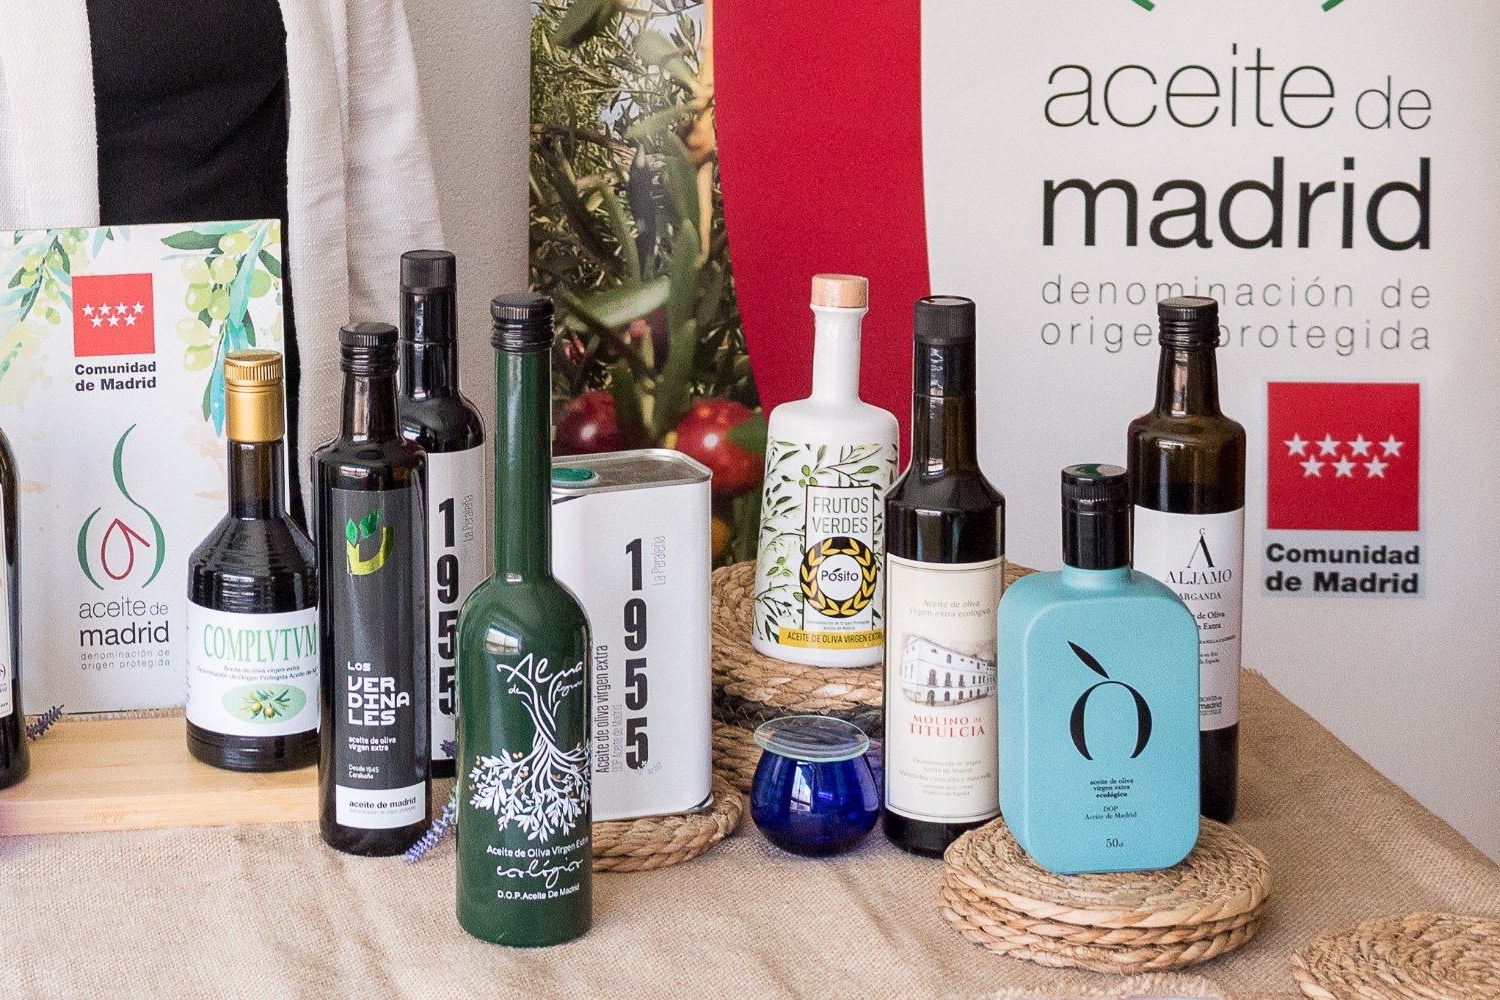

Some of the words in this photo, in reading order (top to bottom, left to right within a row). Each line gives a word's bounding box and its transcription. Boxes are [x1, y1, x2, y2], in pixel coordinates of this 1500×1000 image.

[1044, 43, 1335, 128] aceite
[1355, 75, 1432, 130] de
[1042, 156, 1432, 250] madrid
[1041, 274, 1354, 308] denominación
[1381, 278, 1431, 309] de
[1041, 316, 1153, 353] orige
[75, 361, 156, 375] Comunidad
[75, 380, 95, 391] de
[100, 376, 156, 390] Madrid
[813, 497, 869, 513] FRUTOS
[812, 517, 868, 533] VERDES
[1266, 543, 1420, 565] Comunidad
[652, 575, 666, 586] La
[1165, 568, 1232, 585] ALJAMO
[1265, 570, 1302, 591] de
[1313, 572, 1419, 593] Madrid
[79, 596, 146, 619] aceite
[150, 602, 169, 616] de
[923, 600, 948, 608] Aceite
[950, 600, 960, 608] de
[963, 600, 980, 608] oliva
[1207, 611, 1225, 619] Oliva
[80, 620, 169, 647] madrid
[204, 621, 317, 662] COMPLVTVM
[787, 632, 809, 642] ACEITE
[811, 634, 820, 642] DE
[822, 634, 842, 643] OLIVA
[844, 634, 867, 643] VIRGEN
[81, 650, 152, 660] denominación
[595, 645, 608, 673] extra
[623, 537, 649, 770] 1955
[81, 661, 114, 671] origen
[348, 661, 371, 671] LOS
[348, 676, 395, 693] VER
[594, 674, 611, 703] virgen
[348, 692, 410, 709] DINA
[348, 709, 395, 726] LES
[595, 705, 609, 725] oliva
[913, 714, 969, 726] MOLINO
[595, 726, 610, 742] de
[910, 723, 985, 738] TITULCIA
[348, 736, 369, 744] aceite
[370, 736, 379, 744] de
[380, 736, 396, 744] oliva
[348, 743, 370, 753] virgen
[595, 743, 610, 773] Aceite
[349, 800, 374, 809] aceite
[376, 801, 387, 809] de
[389, 796, 416, 807] madrid
[486, 844, 513, 857] Aceite
[514, 848, 526, 857] de
[527, 848, 550, 857] Oliva
[551, 842, 575, 855] Virgen
[559, 883, 580, 896] Madrid
